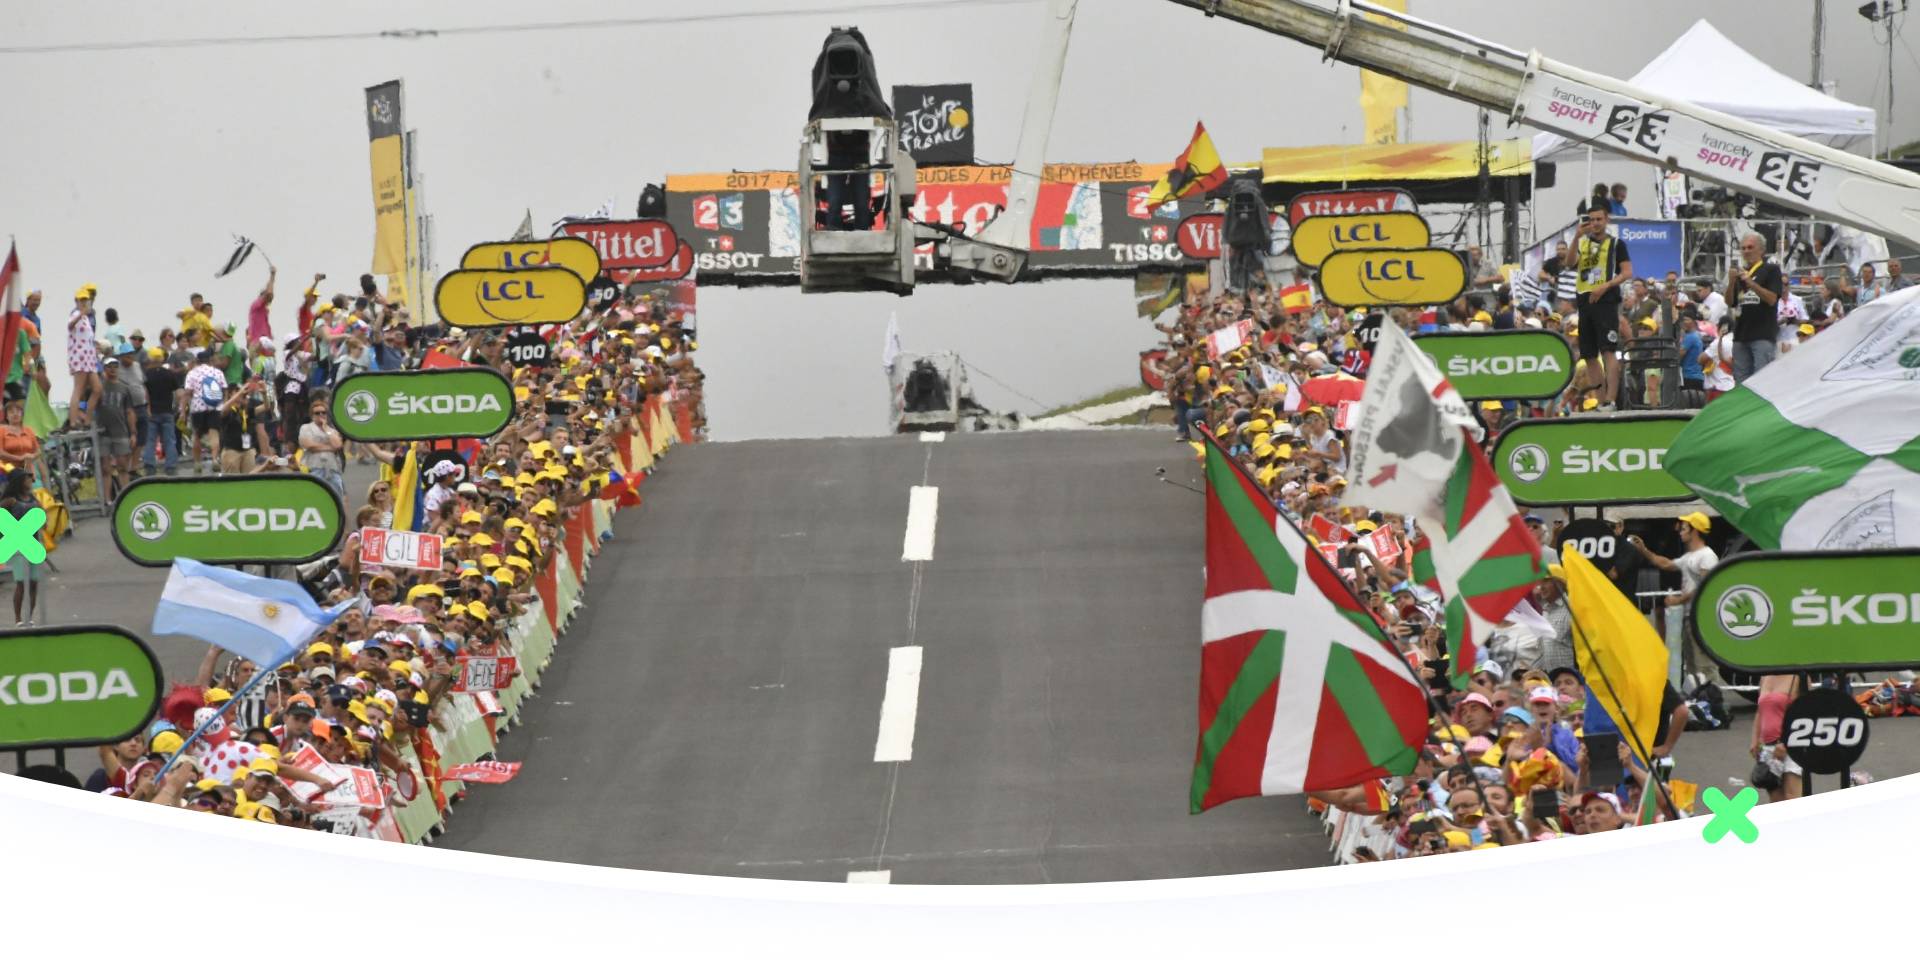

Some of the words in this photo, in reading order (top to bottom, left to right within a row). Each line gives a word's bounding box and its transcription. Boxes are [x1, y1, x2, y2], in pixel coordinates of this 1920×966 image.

[1548, 100, 1598, 124] sport
[1697, 146, 1749, 171] sport
[727, 174, 770, 188] 2017
[1333, 223, 1391, 244] LCL
[1621, 227, 1668, 241] Sporten
[694, 252, 764, 270] ISSOT
[1109, 243, 1183, 262] TISSO
[1364, 259, 1426, 282] LCL
[482, 279, 545, 301] LCL
[1360, 327, 1381, 343] 10
[510, 343, 547, 361] 100
[1447, 354, 1562, 377] ŠKODA
[387, 391, 502, 416] ŠKODA
[1561, 444, 1668, 474] ŠKOD
[183, 504, 327, 533] ŠKODA
[386, 533, 417, 561] GIL
[1791, 588, 1920, 627] ŠKO
[1787, 717, 1864, 748] 250
